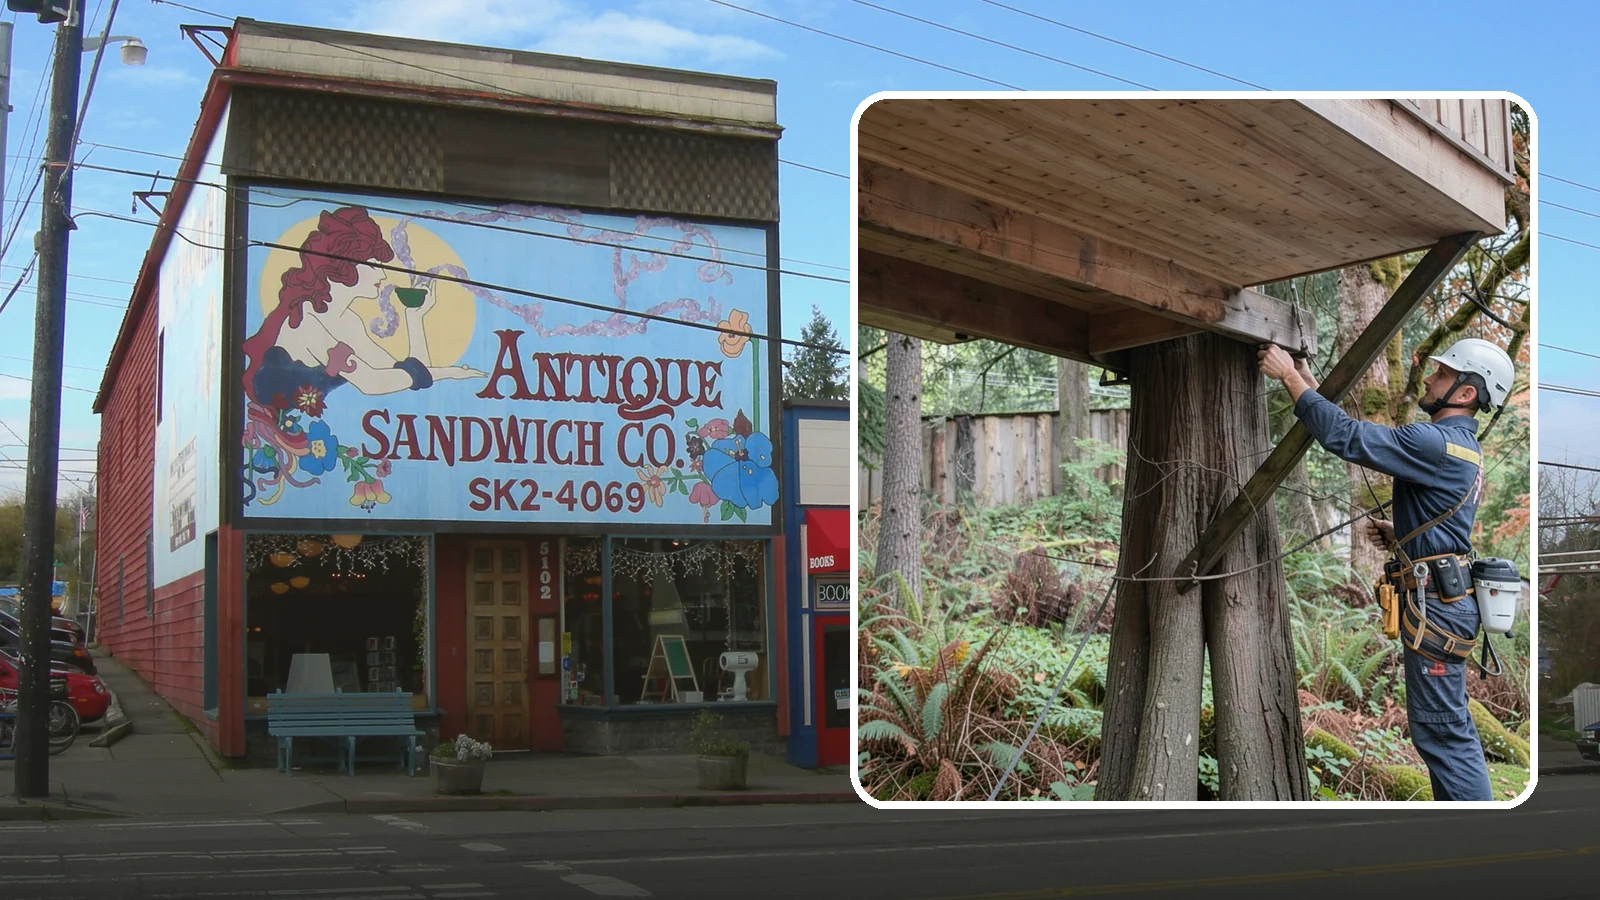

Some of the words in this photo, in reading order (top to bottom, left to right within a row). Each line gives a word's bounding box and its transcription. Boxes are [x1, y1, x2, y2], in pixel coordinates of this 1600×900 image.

[475, 328, 724, 421] ANTIQUE
[361, 408, 605, 467] SANDWICH
[617, 422, 685, 469] CO.
[468, 477, 646, 513] SK2-4069
[540, 541, 552, 600] 5102
[809, 555, 835, 569] BOOKS
